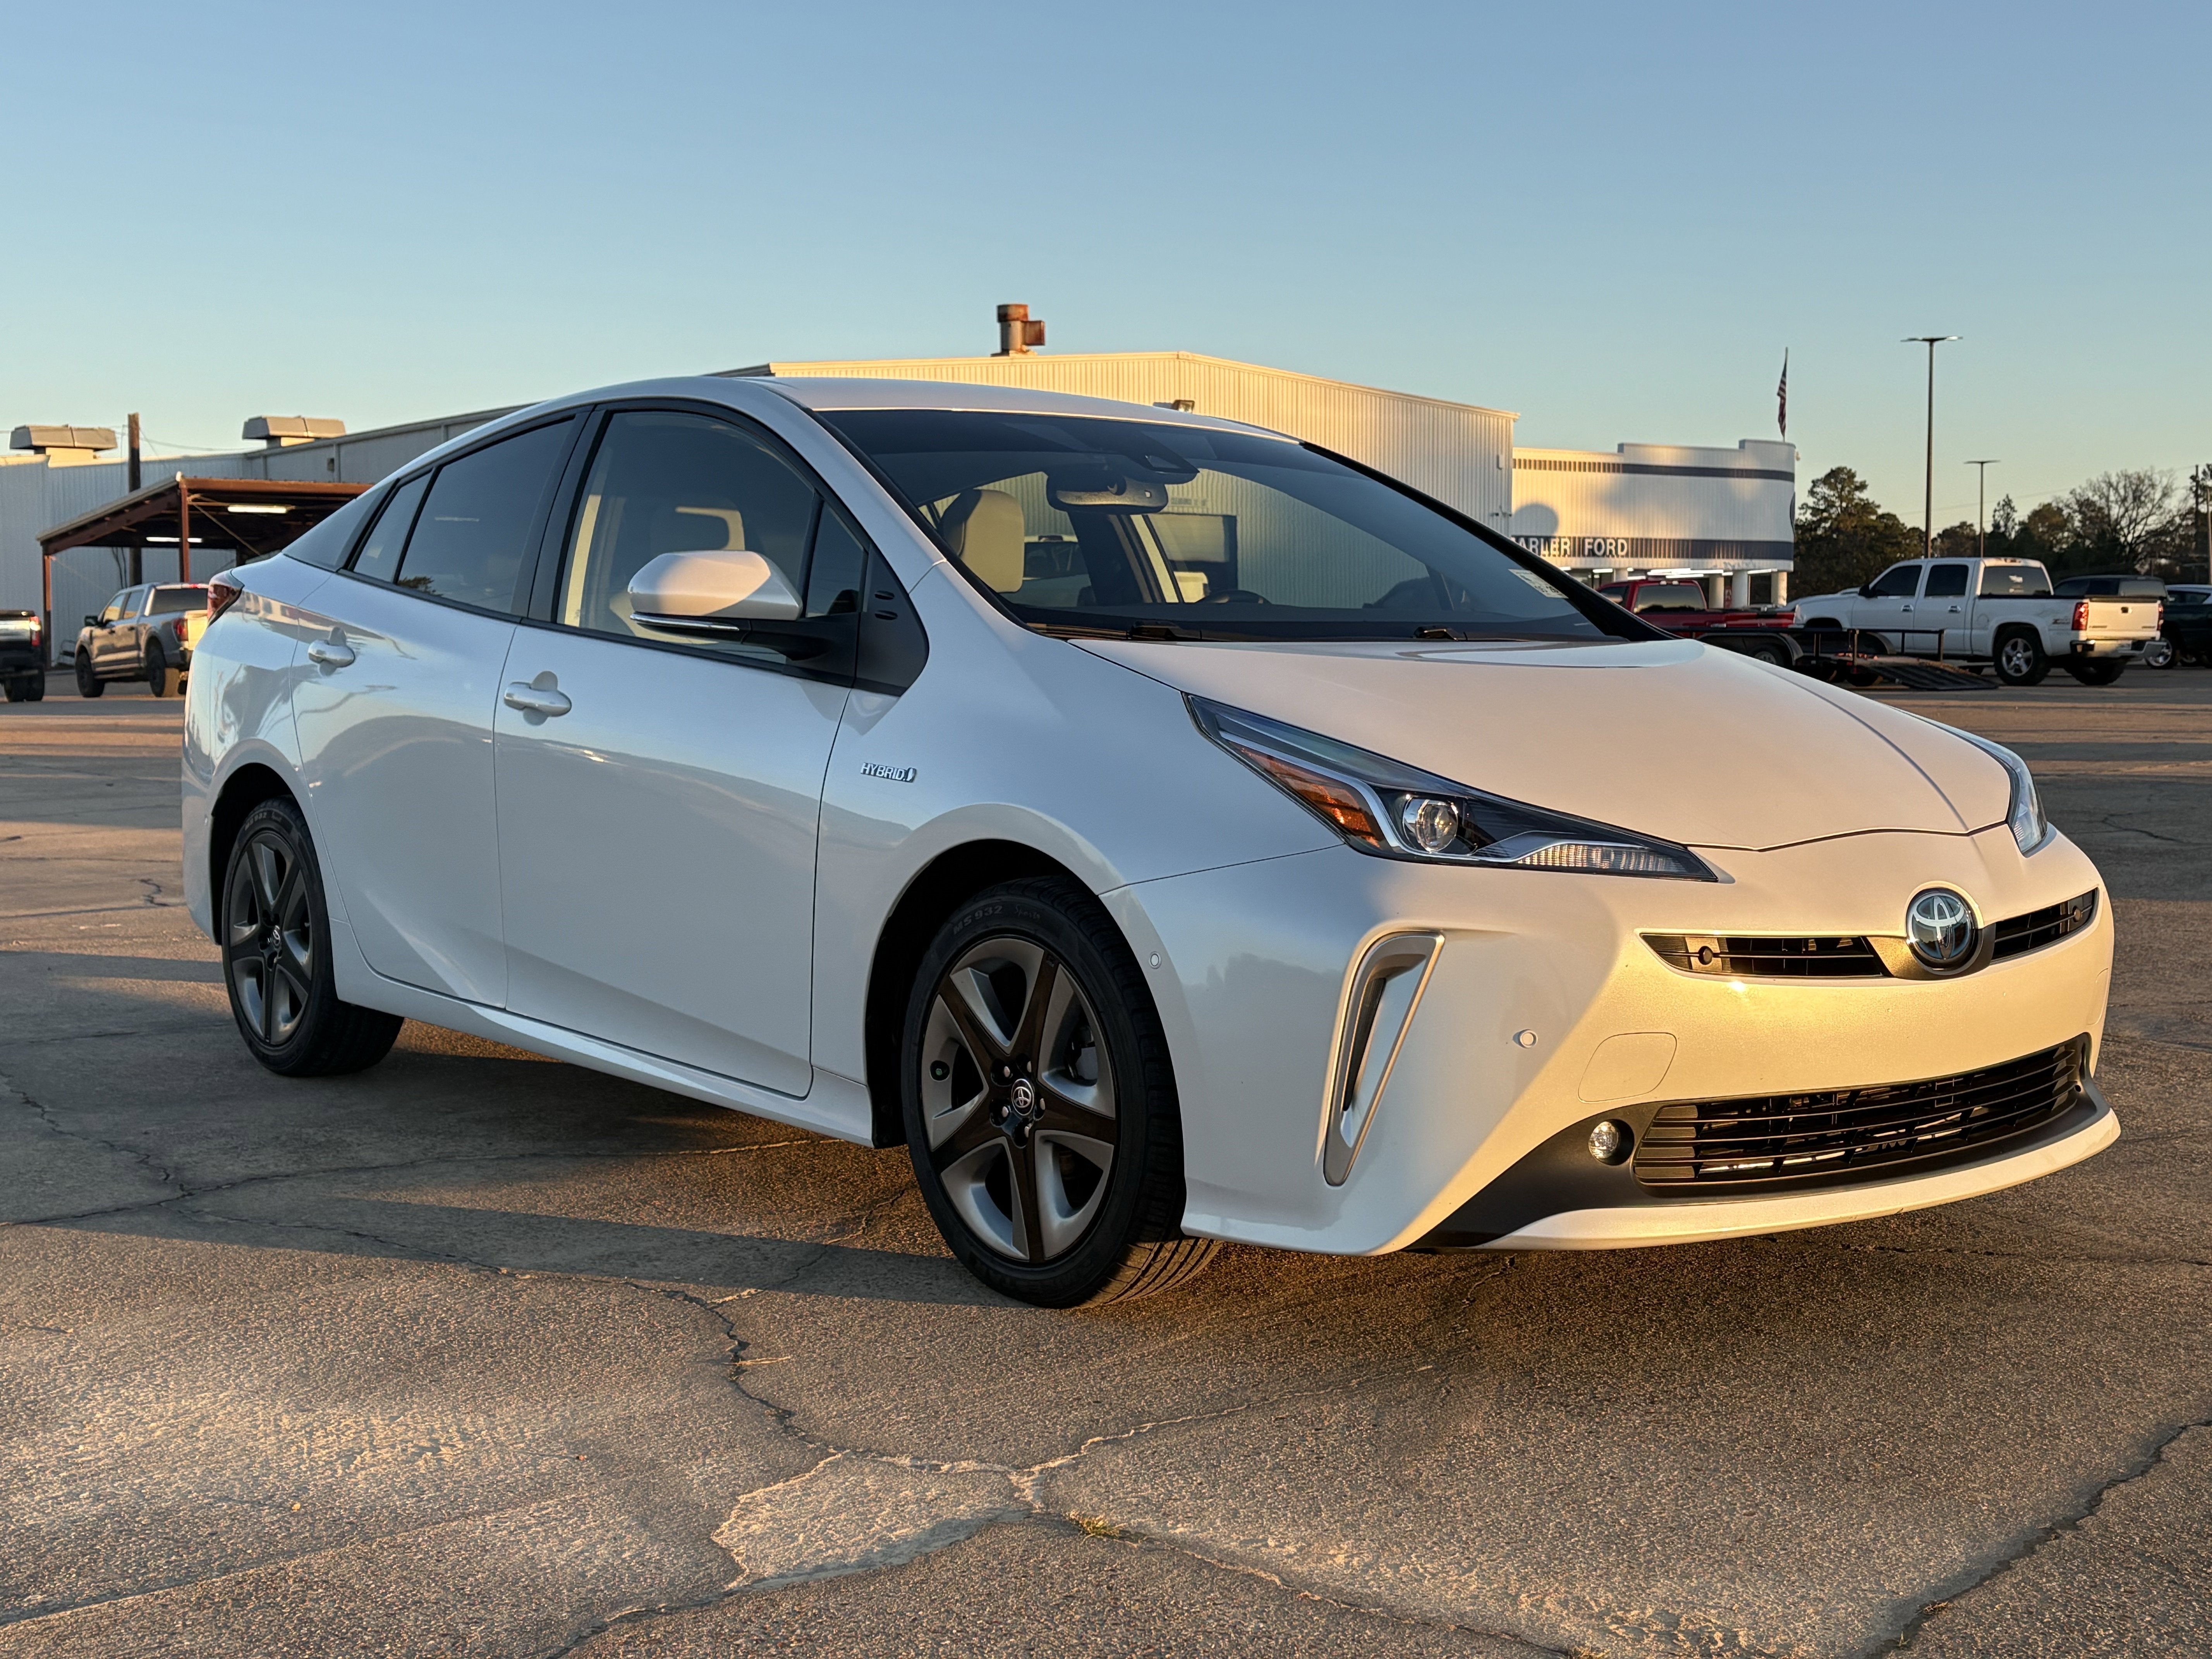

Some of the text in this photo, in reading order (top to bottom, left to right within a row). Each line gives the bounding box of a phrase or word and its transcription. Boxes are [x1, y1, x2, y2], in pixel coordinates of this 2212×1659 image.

[1511, 537, 1627, 556] ARLER FORD
[860, 762, 905, 780] HYBRID
